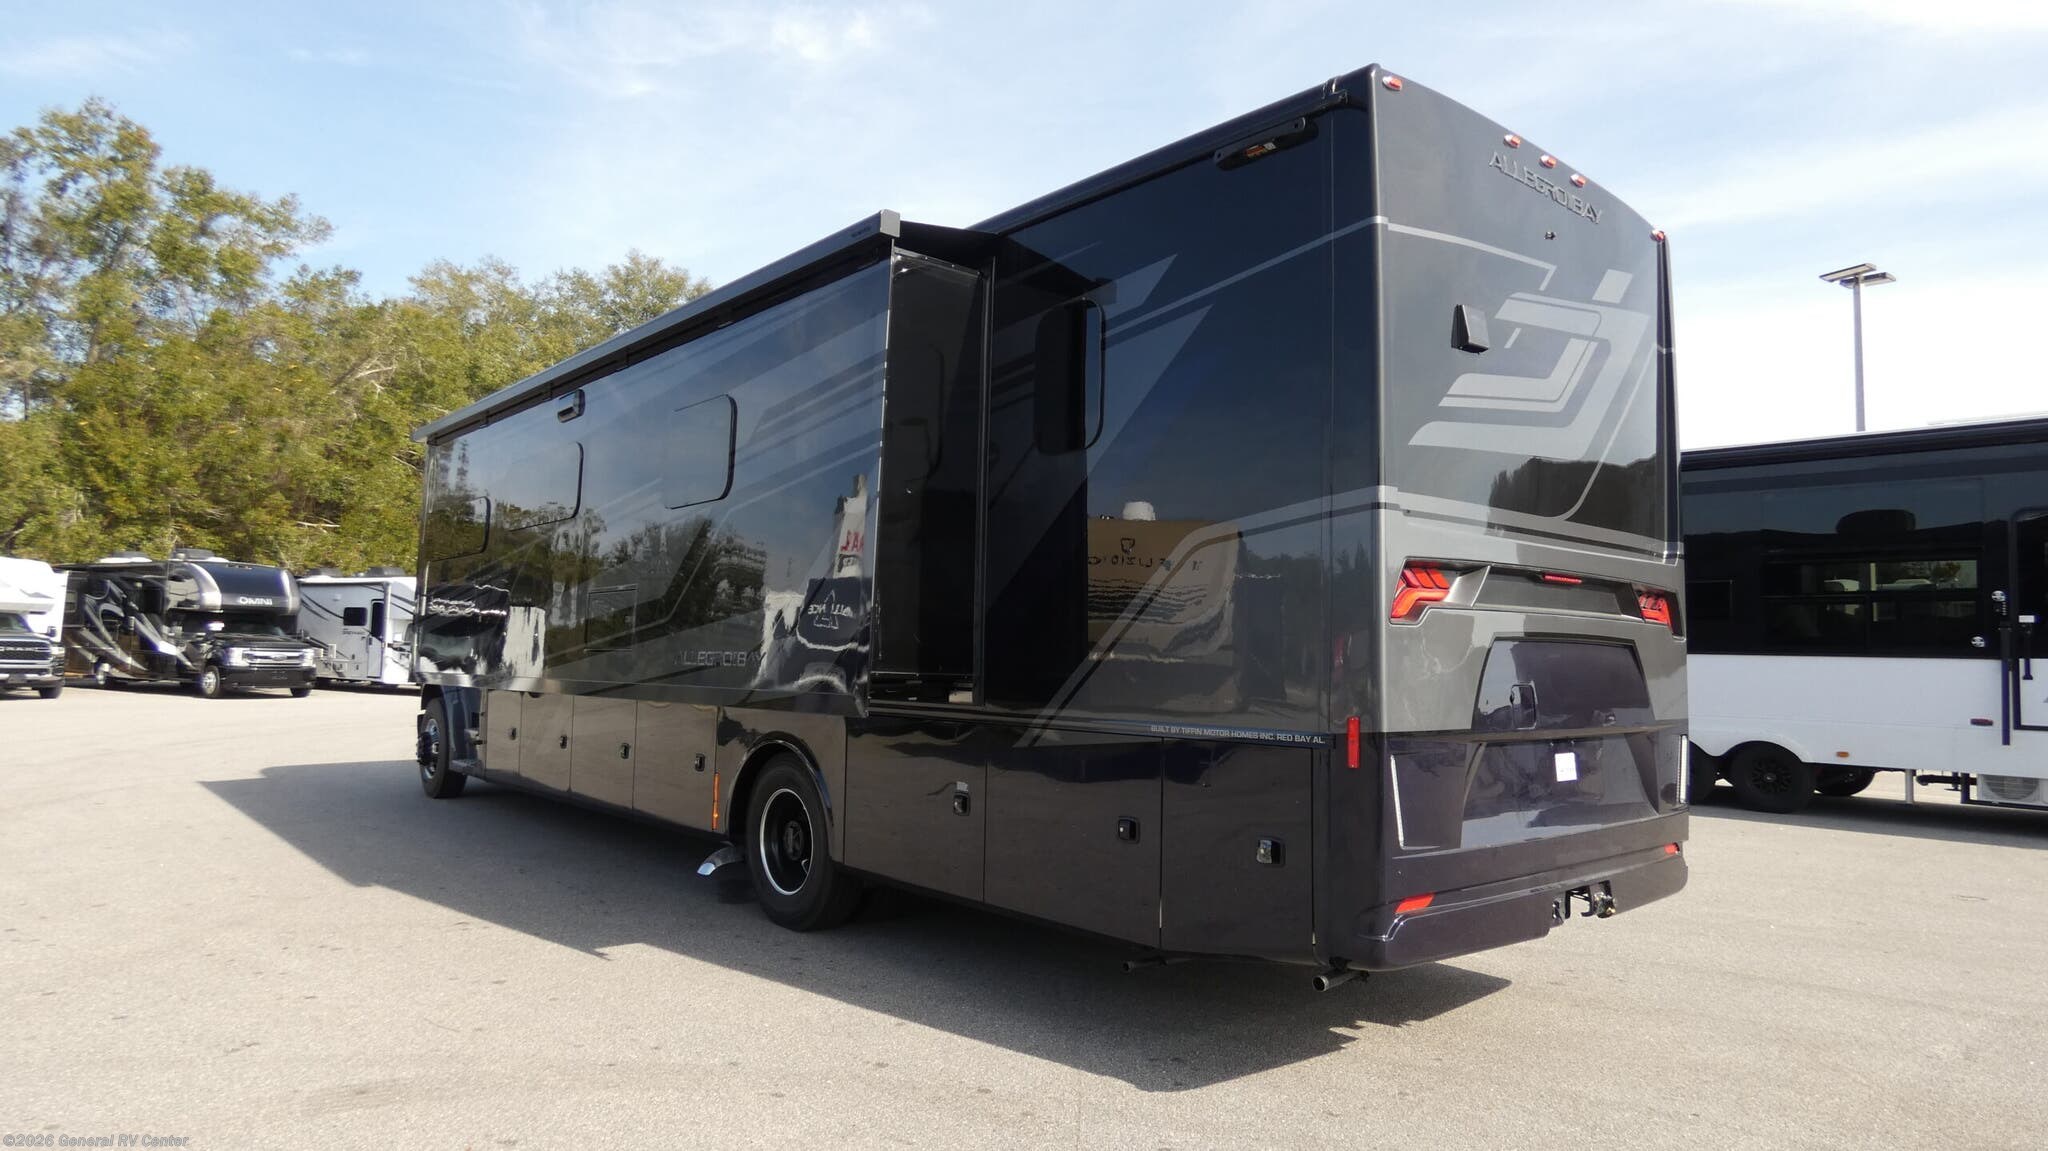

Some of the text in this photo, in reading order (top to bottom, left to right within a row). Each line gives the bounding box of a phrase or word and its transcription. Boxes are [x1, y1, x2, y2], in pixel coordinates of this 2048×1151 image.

[1488, 151, 1602, 225] ALLEGRO BAY
[238, 596, 273, 606] OMNI
[1151, 725, 1170, 733] BUILT
[1171, 726, 1181, 734] BY
[1181, 727, 1202, 736] TIFFIN
[1202, 729, 1231, 738] MOTOR
[1231, 730, 1259, 739] HOMES
[1276, 733, 1293, 742] RED
[1294, 734, 1311, 743] BAY
